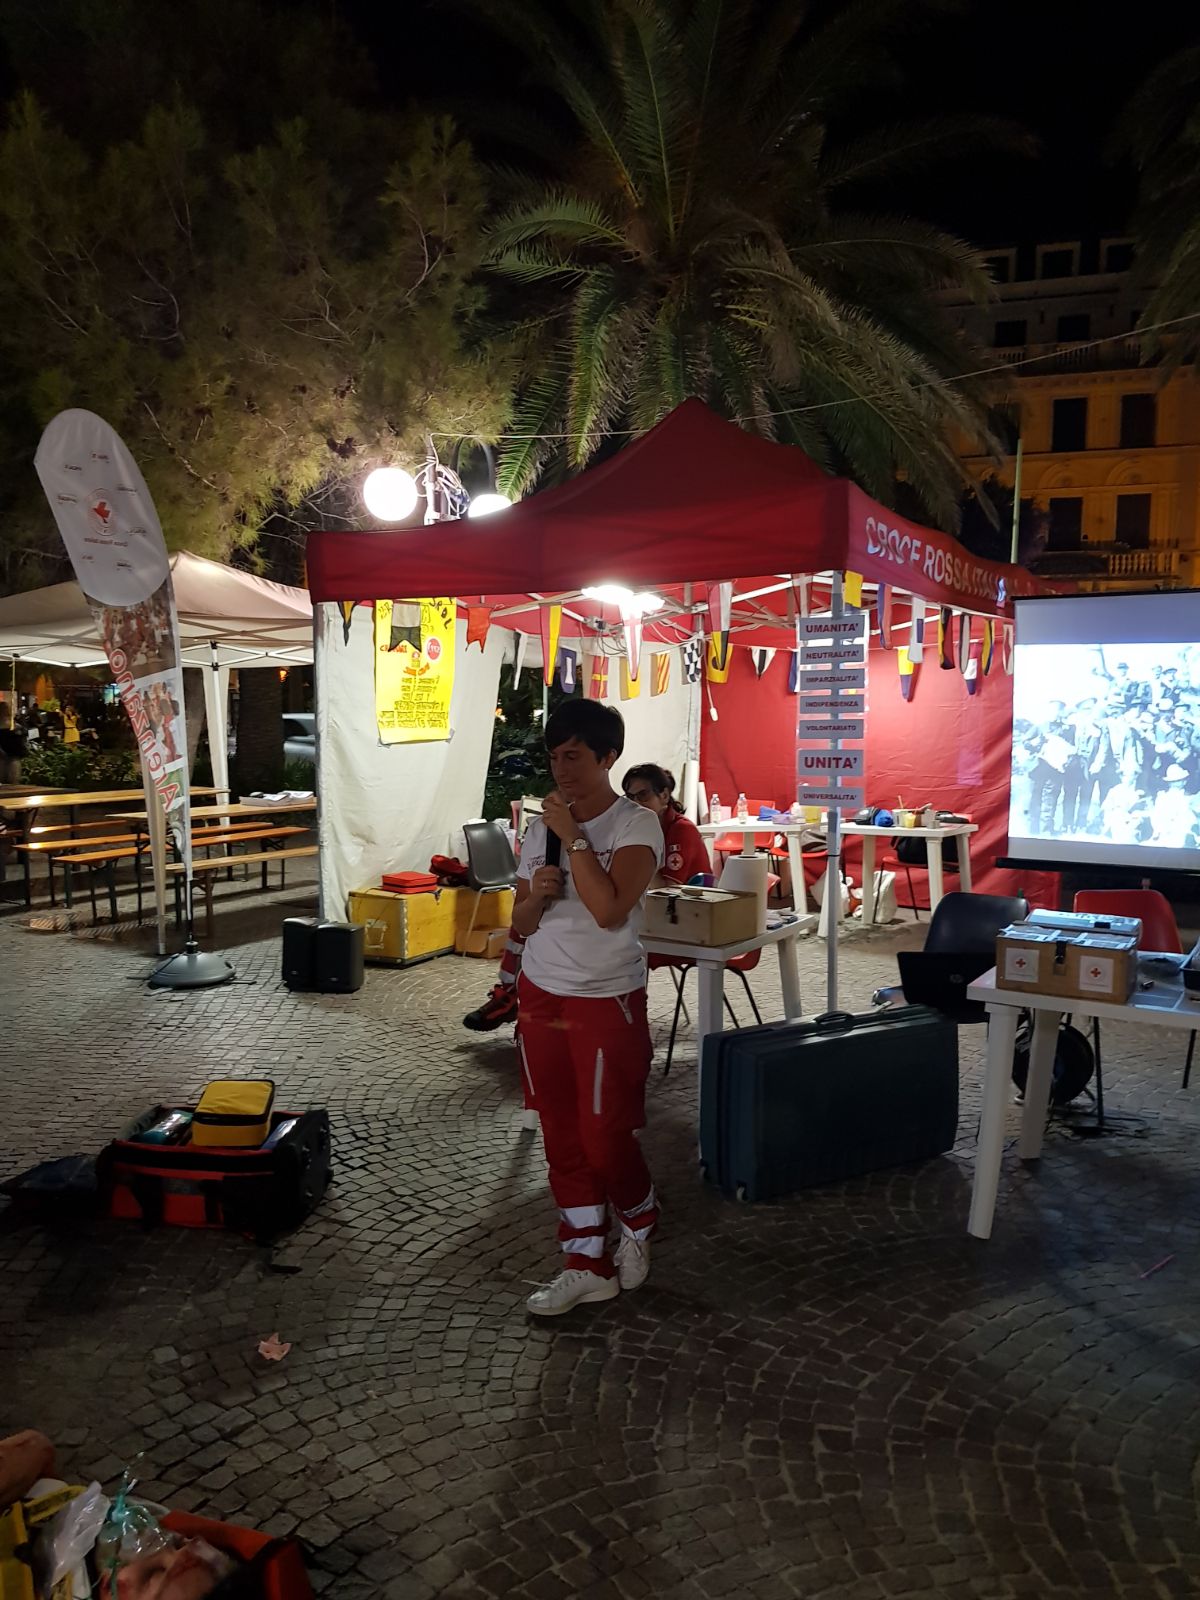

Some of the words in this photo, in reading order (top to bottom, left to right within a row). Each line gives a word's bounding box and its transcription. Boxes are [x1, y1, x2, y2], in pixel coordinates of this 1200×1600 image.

[923, 544, 971, 593] ROSSA
[806, 623, 859, 633] UMANITA'
[806, 650, 859, 659] NEUTRALITA'
[804, 756, 857, 769] UNITA'
